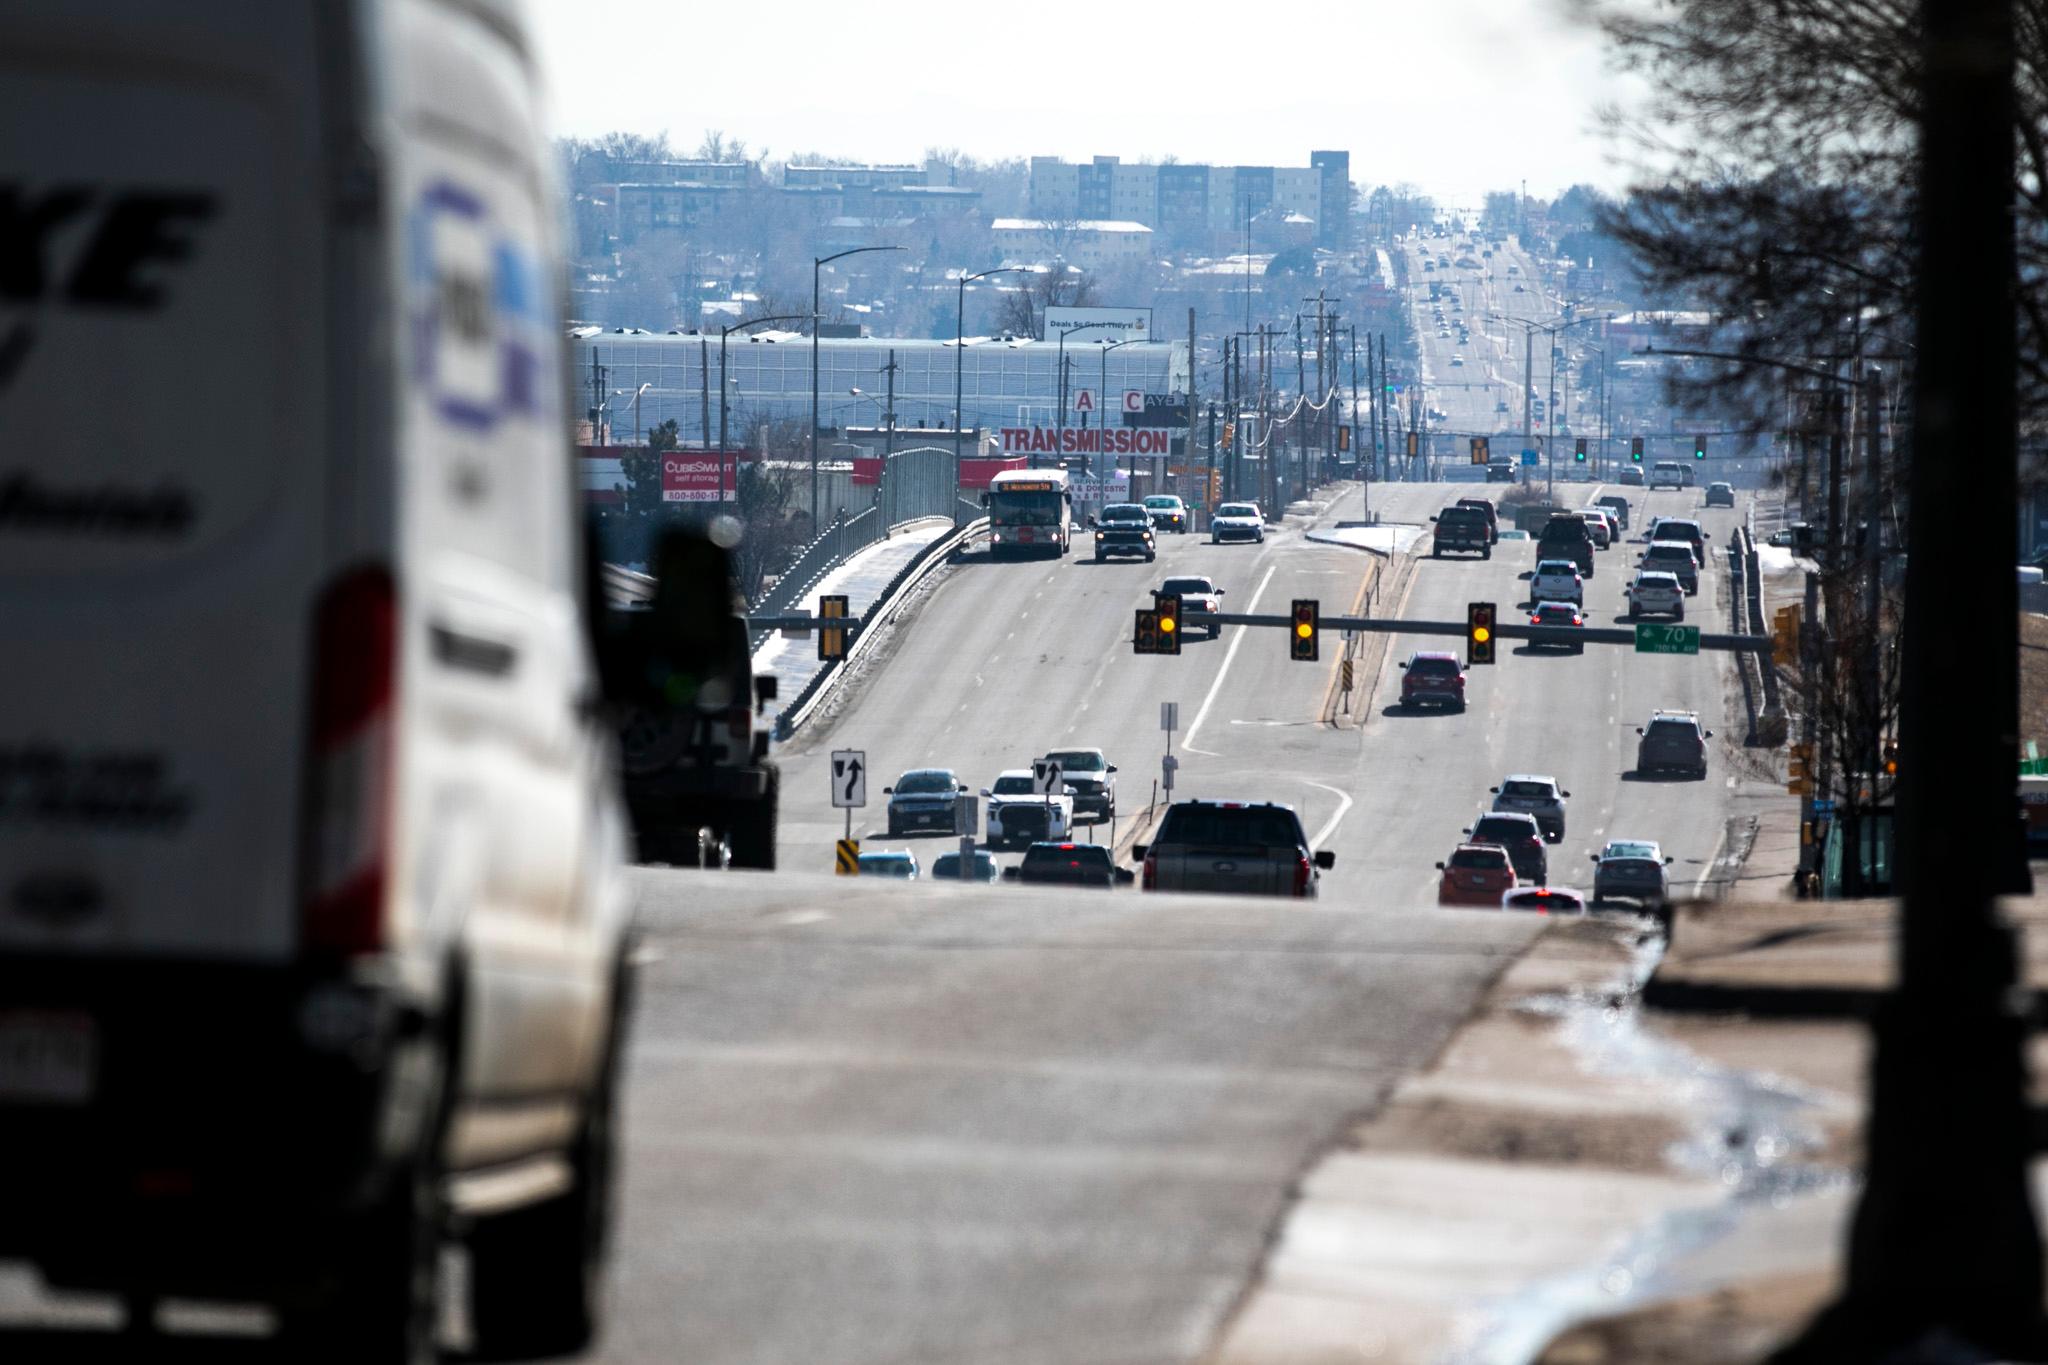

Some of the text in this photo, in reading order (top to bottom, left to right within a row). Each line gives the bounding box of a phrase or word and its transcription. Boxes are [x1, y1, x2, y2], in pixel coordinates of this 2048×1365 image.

[1050, 320, 1071, 328] Deals
[1076, 391, 1093, 410] A
[1126, 392, 1141, 411] C
[1001, 428, 1168, 454] TRANSMISSION
[692, 475, 722, 484] storag
[669, 491, 729, 500] 800-800-177
[1664, 627, 1685, 642] 70
